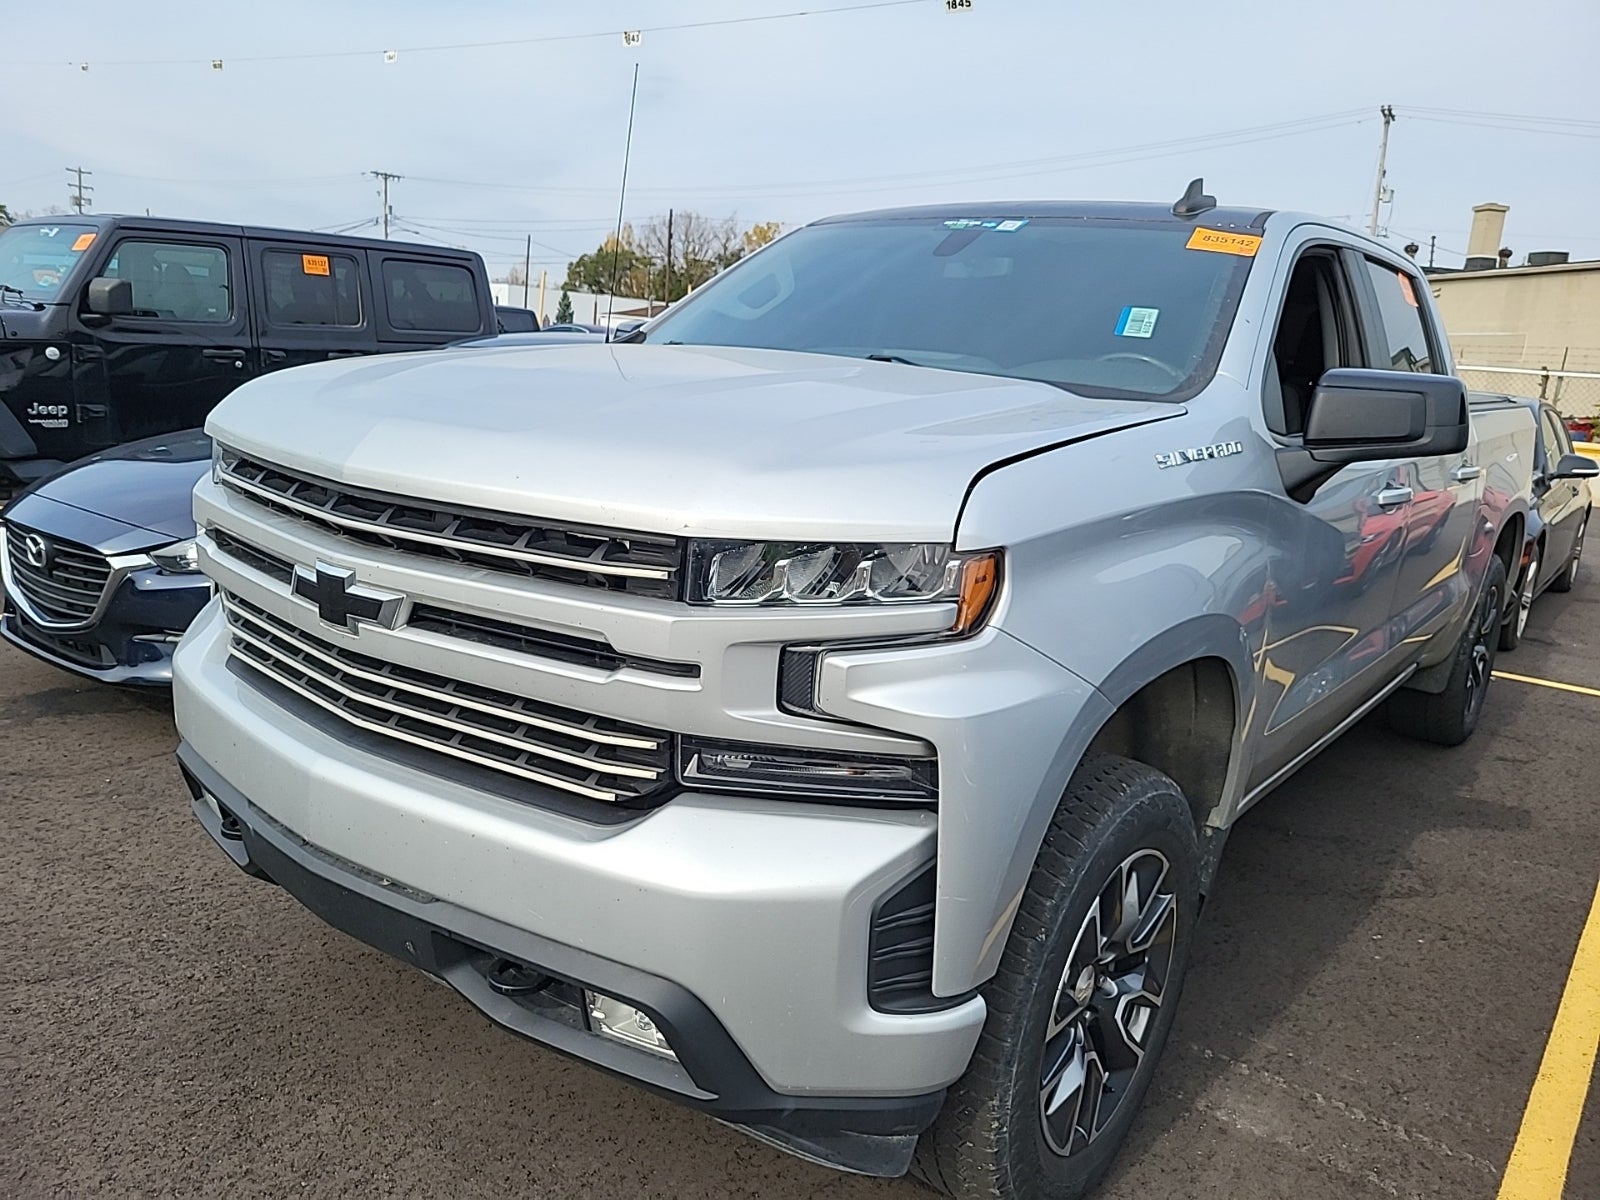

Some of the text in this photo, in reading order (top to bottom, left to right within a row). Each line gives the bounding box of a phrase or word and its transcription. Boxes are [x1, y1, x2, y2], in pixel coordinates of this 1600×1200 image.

[946, 0, 971, 10] 1845
[27, 402, 68, 417] Jeep
[1154, 441, 1243, 469] SILVERADO
